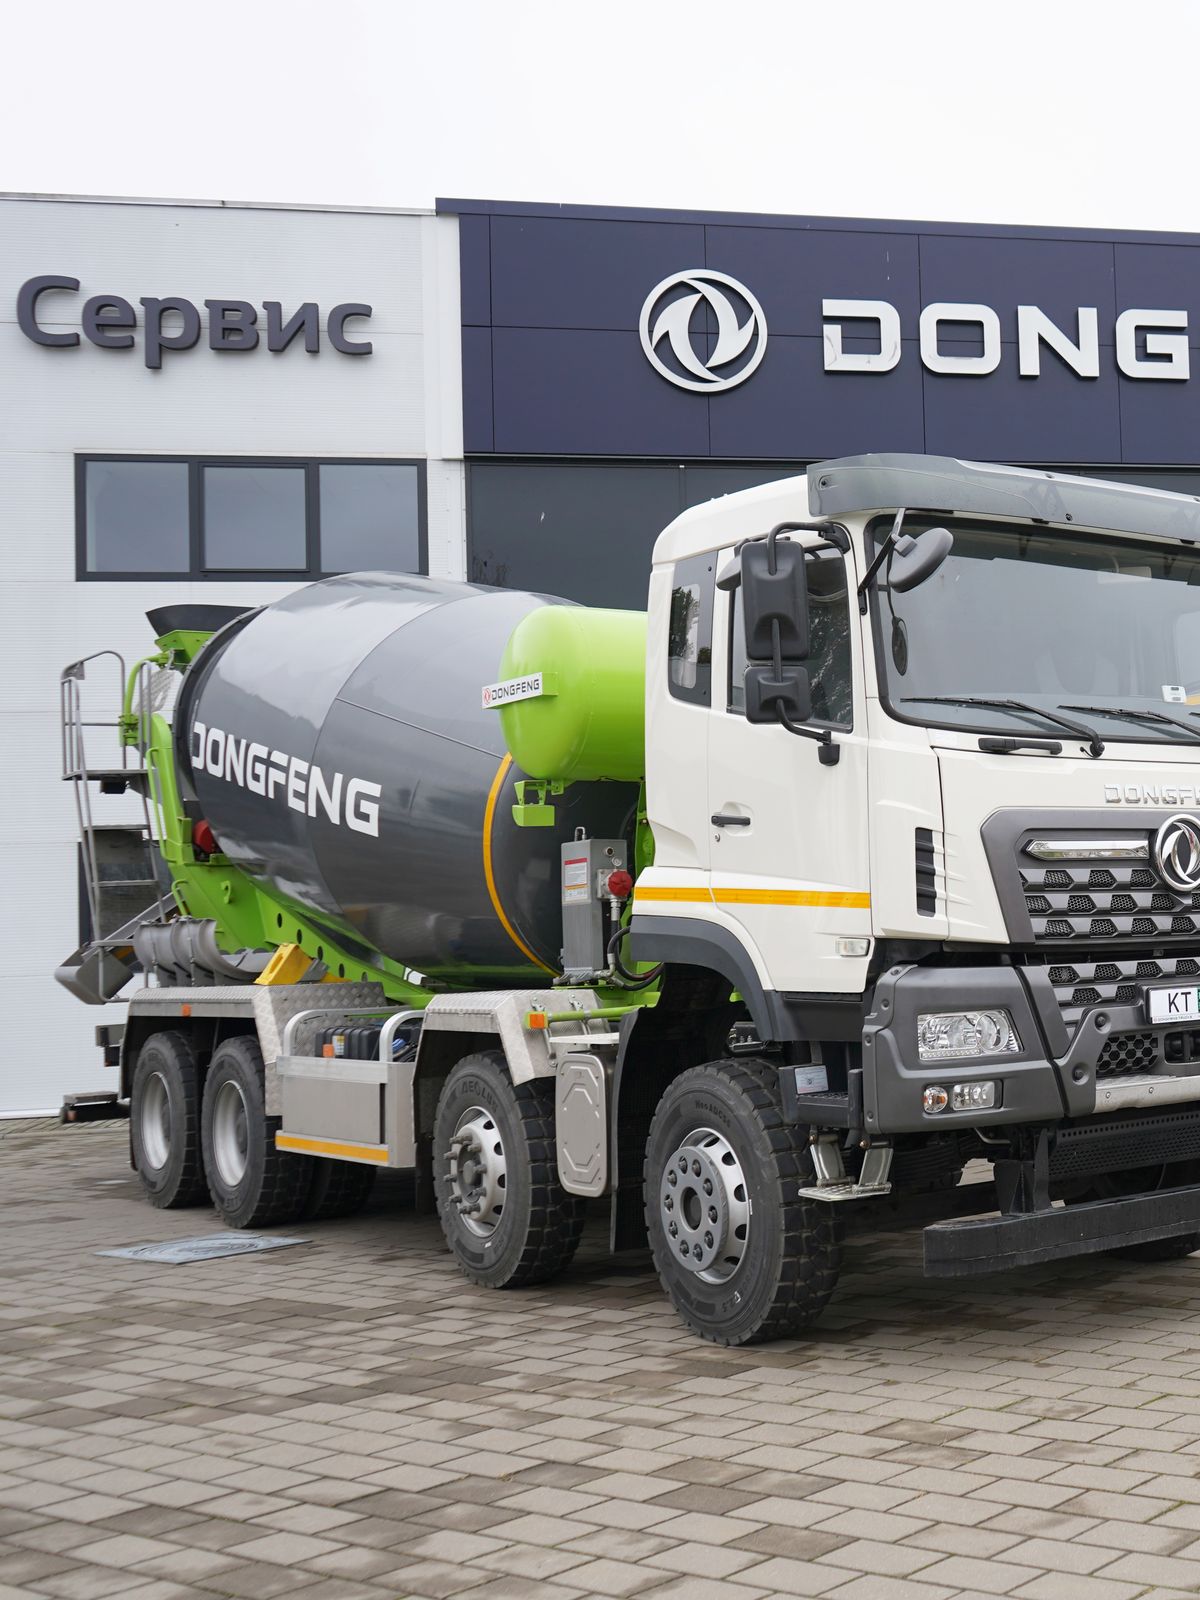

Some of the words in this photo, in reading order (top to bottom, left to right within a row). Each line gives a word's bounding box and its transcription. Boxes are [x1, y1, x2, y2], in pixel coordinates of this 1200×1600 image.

[16, 274, 374, 370] Сервис
[491, 678, 540, 701] DONGFENG
[1168, 991, 1192, 1014] KT
